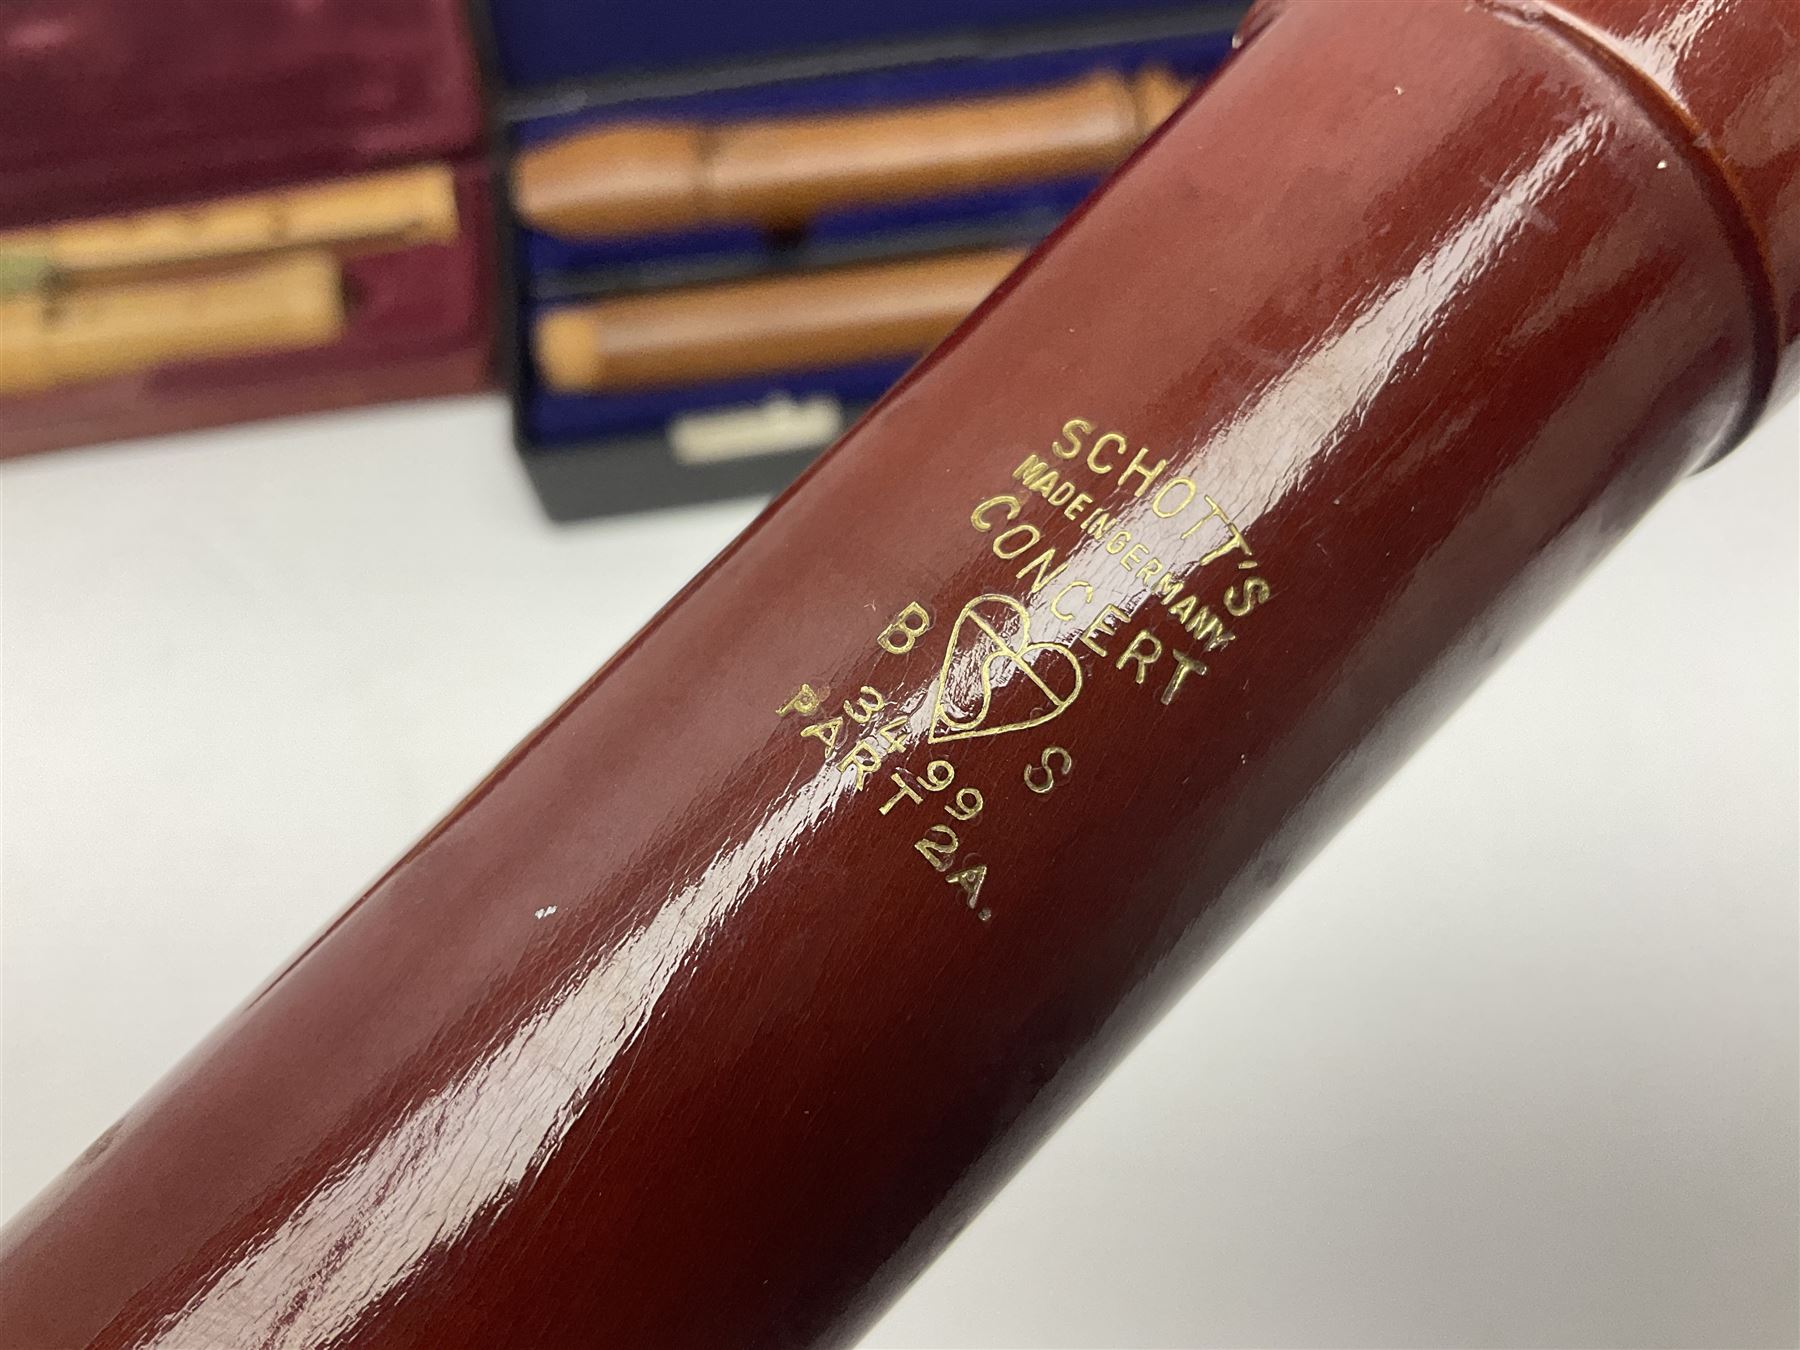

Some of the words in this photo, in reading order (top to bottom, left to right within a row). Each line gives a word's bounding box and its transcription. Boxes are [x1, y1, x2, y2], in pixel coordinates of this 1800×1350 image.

[970, 496, 1208, 705] CONCERT
[1012, 454, 1093, 521] MADE
[1080, 508, 1119, 541] IN
[1105, 530, 1237, 652] GERMANY
[1052, 419, 1270, 616] SCHOTT'S
[775, 683, 924, 816] PART
[842, 685, 984, 821] 3499
[876, 601, 930, 655] B
[1023, 746, 1072, 794] S
